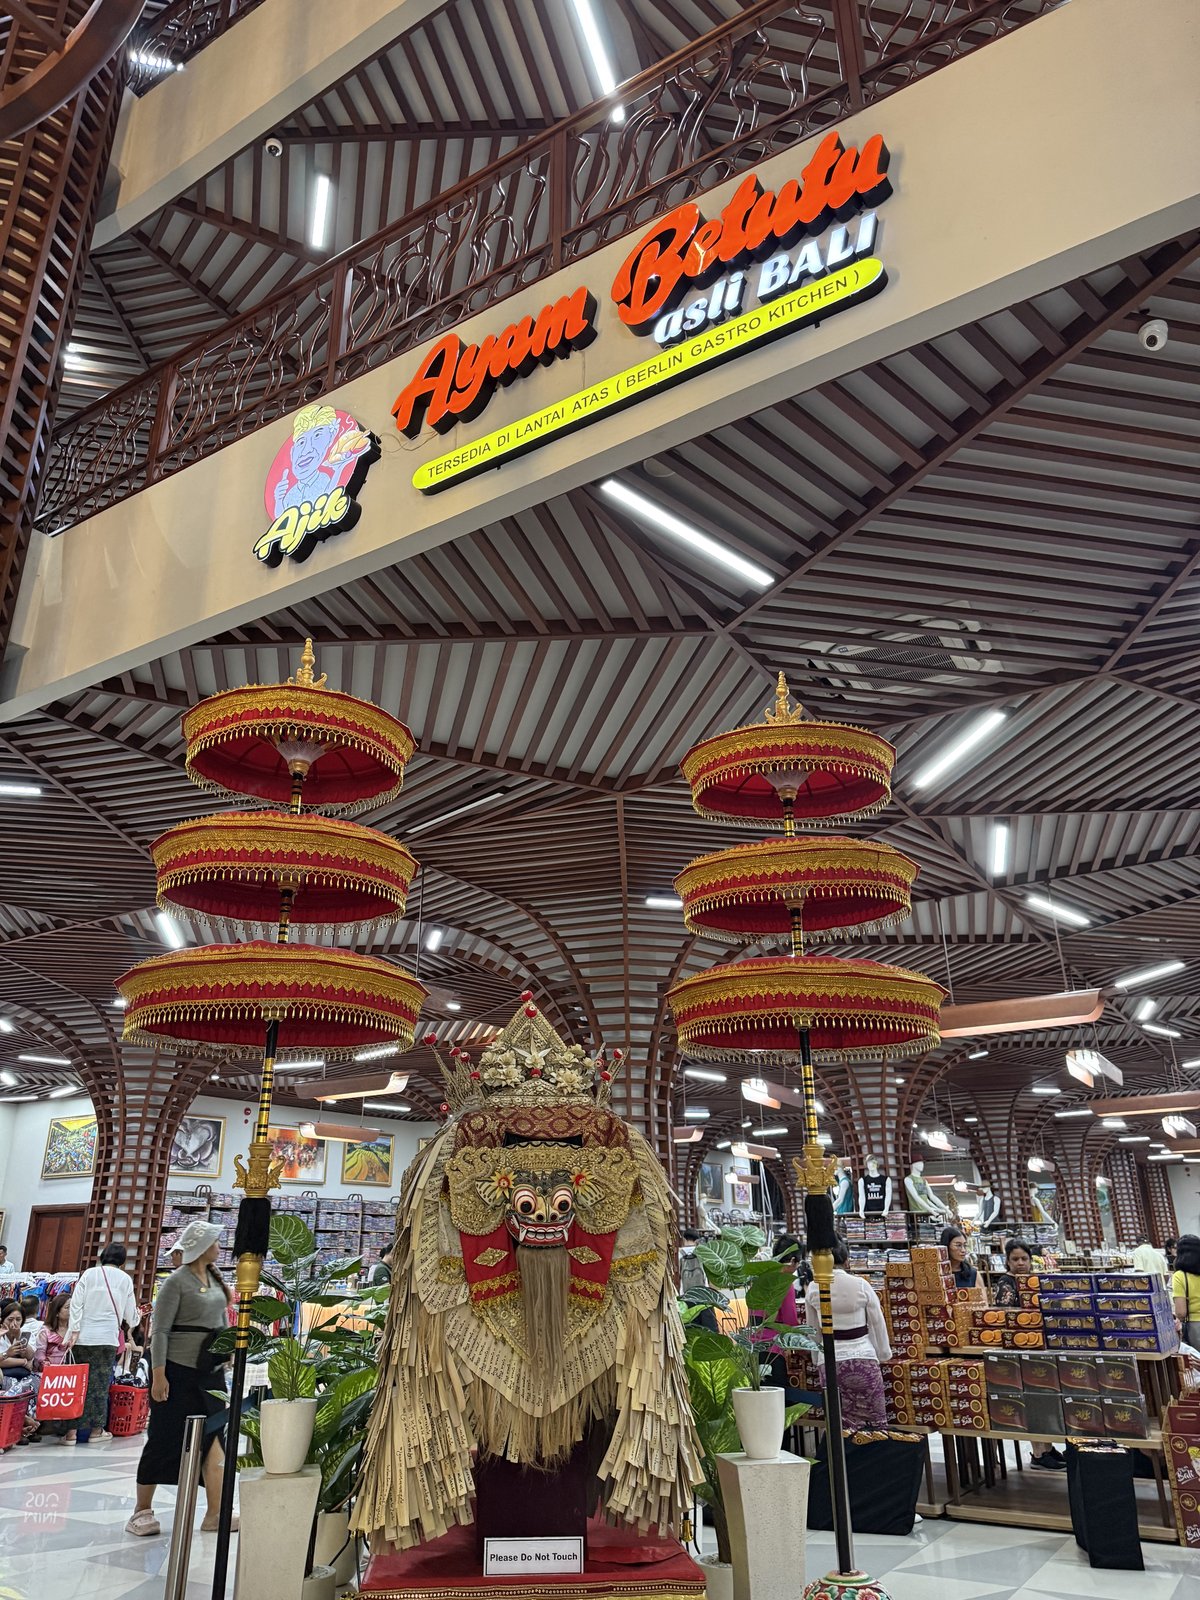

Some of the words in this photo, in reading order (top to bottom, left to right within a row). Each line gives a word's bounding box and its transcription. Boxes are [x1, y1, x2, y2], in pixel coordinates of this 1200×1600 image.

[391, 286, 590, 431] Ayam
[610, 131, 888, 326] Betutu
[654, 271, 745, 343] asli
[757, 212, 877, 298] BALI
[427, 442, 491, 478] TERSEDIA
[497, 434, 510, 448] DI
[515, 407, 565, 438] LANTAI
[571, 387, 609, 413] ATAS
[690, 317, 761, 357] GASTRO
[253, 485, 350, 561] Ajik
[43, 1375, 77, 1389] MINI
[489, 1553, 518, 1562] Please
[520, 1553, 533, 1561] Do
[534, 1552, 550, 1561] Not
[552, 1552, 578, 1561] Touch
